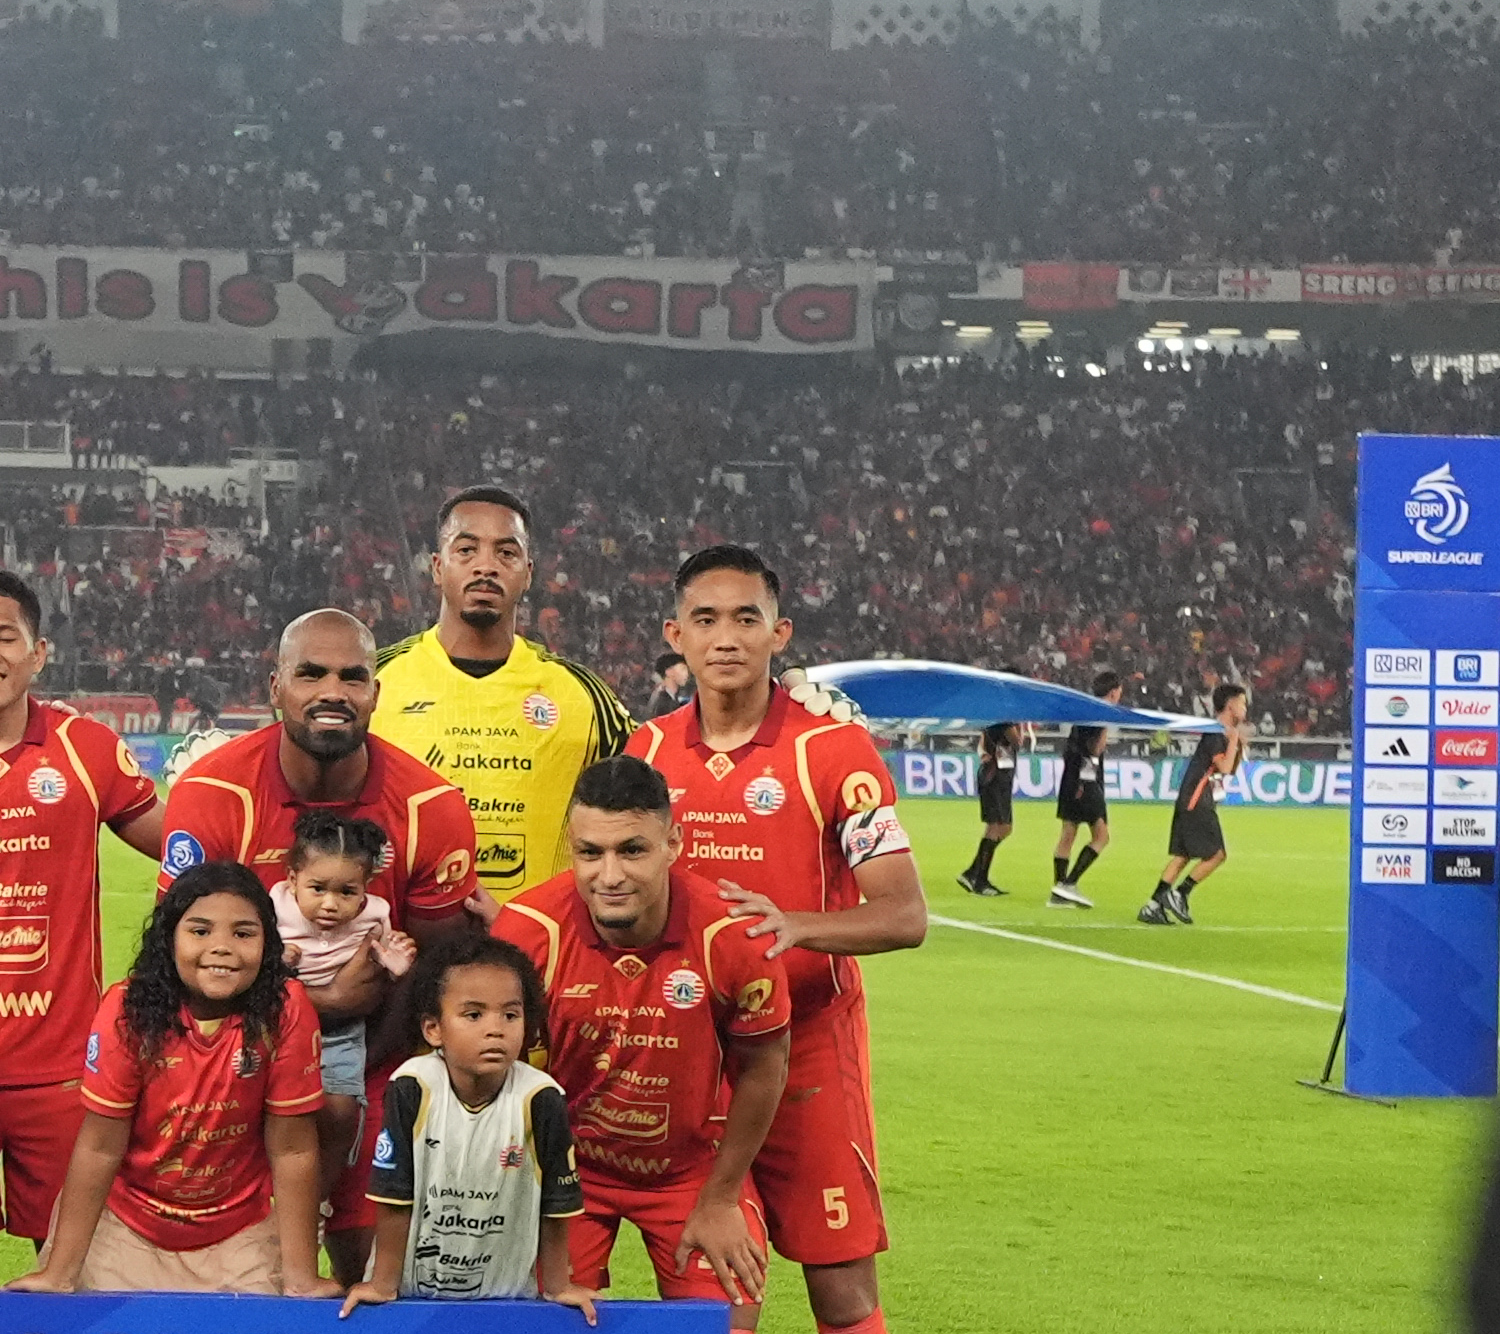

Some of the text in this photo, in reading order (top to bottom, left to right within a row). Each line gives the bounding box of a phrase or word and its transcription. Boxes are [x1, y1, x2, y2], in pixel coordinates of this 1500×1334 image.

[415, 259, 858, 344] akarta
[1421, 502, 1443, 518] BRI
[1395, 656, 1423, 673] BRI
[1458, 657, 1477, 670] BRI
[1442, 700, 1492, 717] Vidio
[452, 727, 519, 738] PAM JAYA
[451, 754, 532, 771] Jakarta
[904, 752, 975, 797] BRI
[469, 797, 525, 813] Bakrie
[1, 806, 36, 820] JAYA
[688, 811, 747, 824] PAM JAYA
[1453, 818, 1476, 828] STOP
[692, 829, 714, 839] Bank
[1443, 828, 1486, 837] BULLYING
[687, 842, 764, 861] Jakarta
[1377, 854, 1412, 866] #VAR
[1457, 856, 1471, 867] NO
[1382, 867, 1412, 878] FAIR
[1446, 867, 1481, 878] RACISM
[440, 1187, 464, 1200] PAM
[823, 1186, 850, 1231] 5
[438, 1253, 493, 1266] Bakrie
